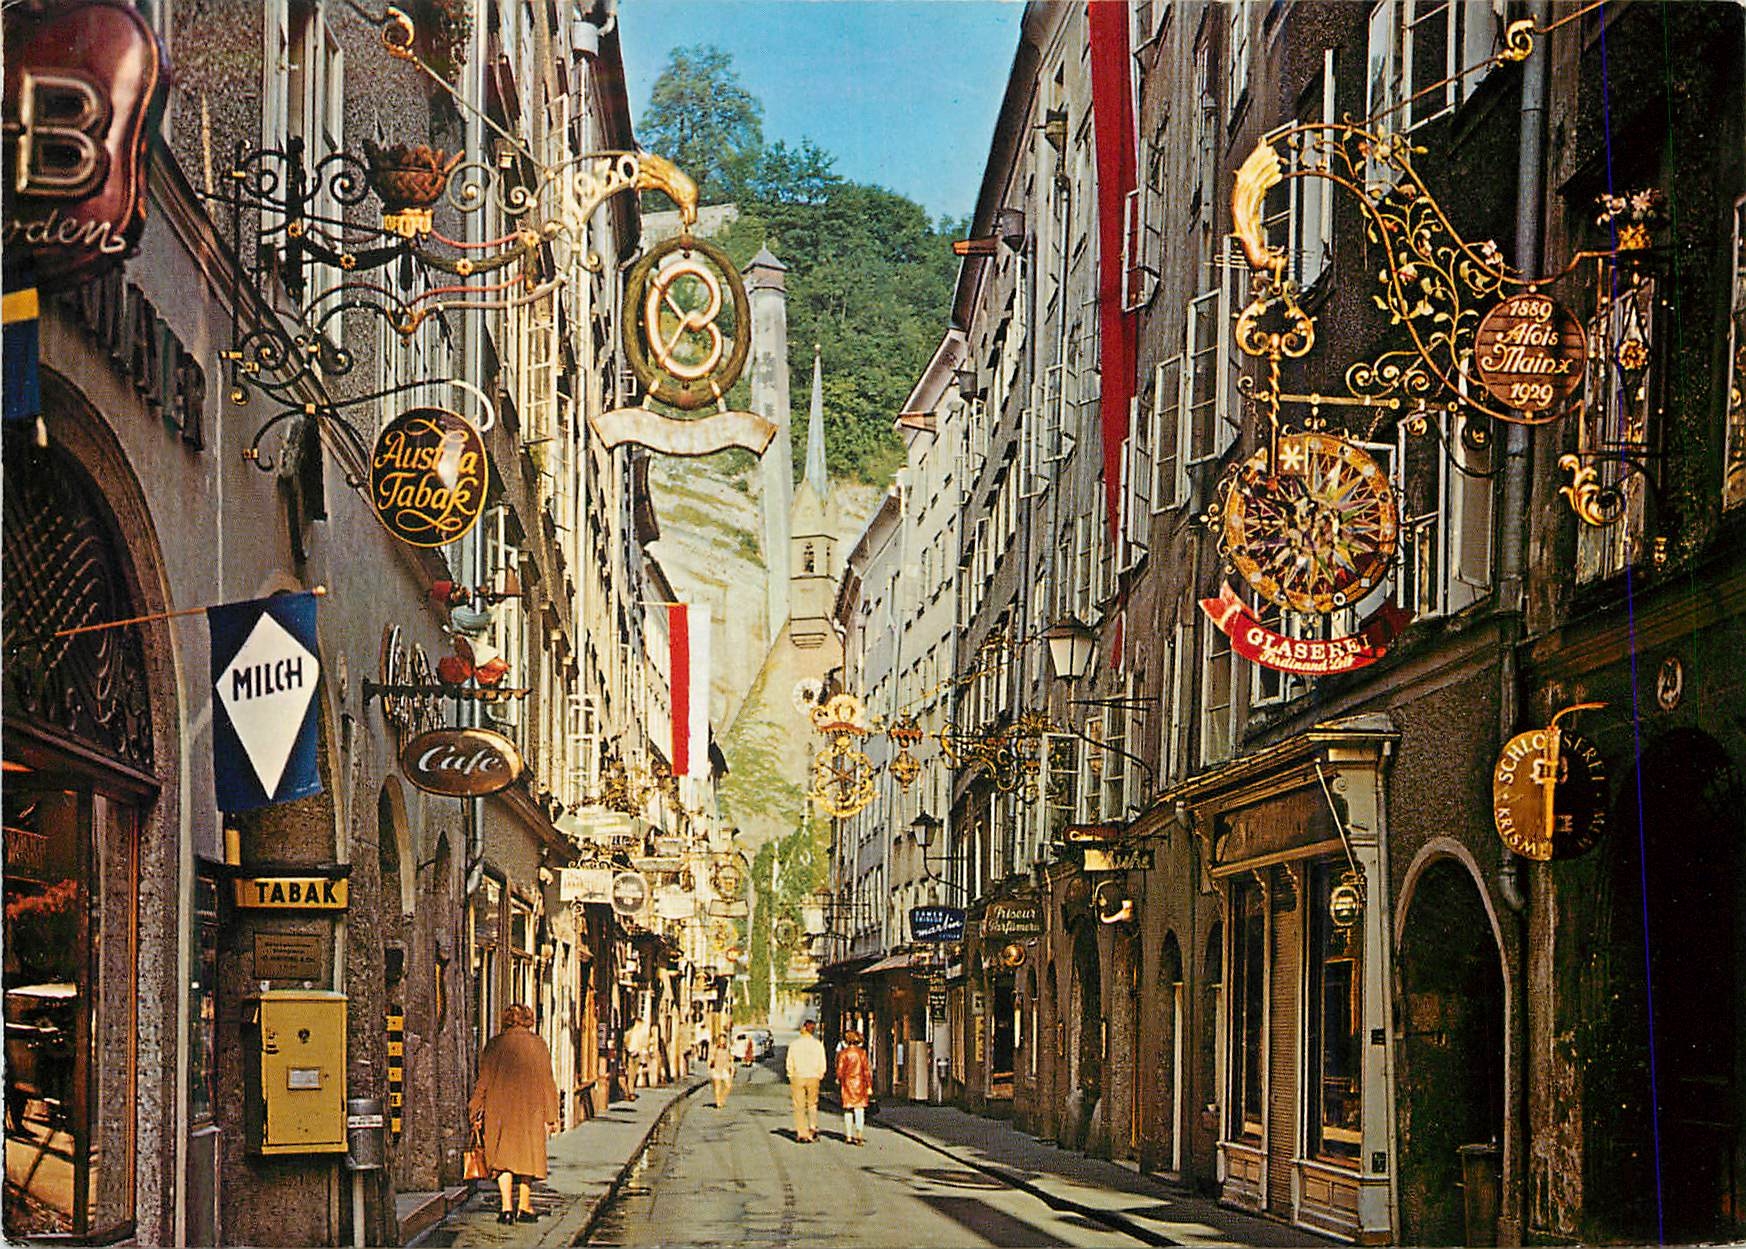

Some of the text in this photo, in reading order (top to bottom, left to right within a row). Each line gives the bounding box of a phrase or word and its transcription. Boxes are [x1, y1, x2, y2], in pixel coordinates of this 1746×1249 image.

[1509, 300, 1553, 323] 1889
[1496, 323, 1559, 346] Alois
[1511, 383, 1554, 407] 1929
[374, 430, 478, 474] Austa
[378, 472, 479, 517] Tabak
[1247, 628, 1371, 660] GLASEREI
[1259, 648, 1328, 671] Ferdinand
[231, 656, 303, 702] MILCH
[255, 881, 337, 903] TABAK
